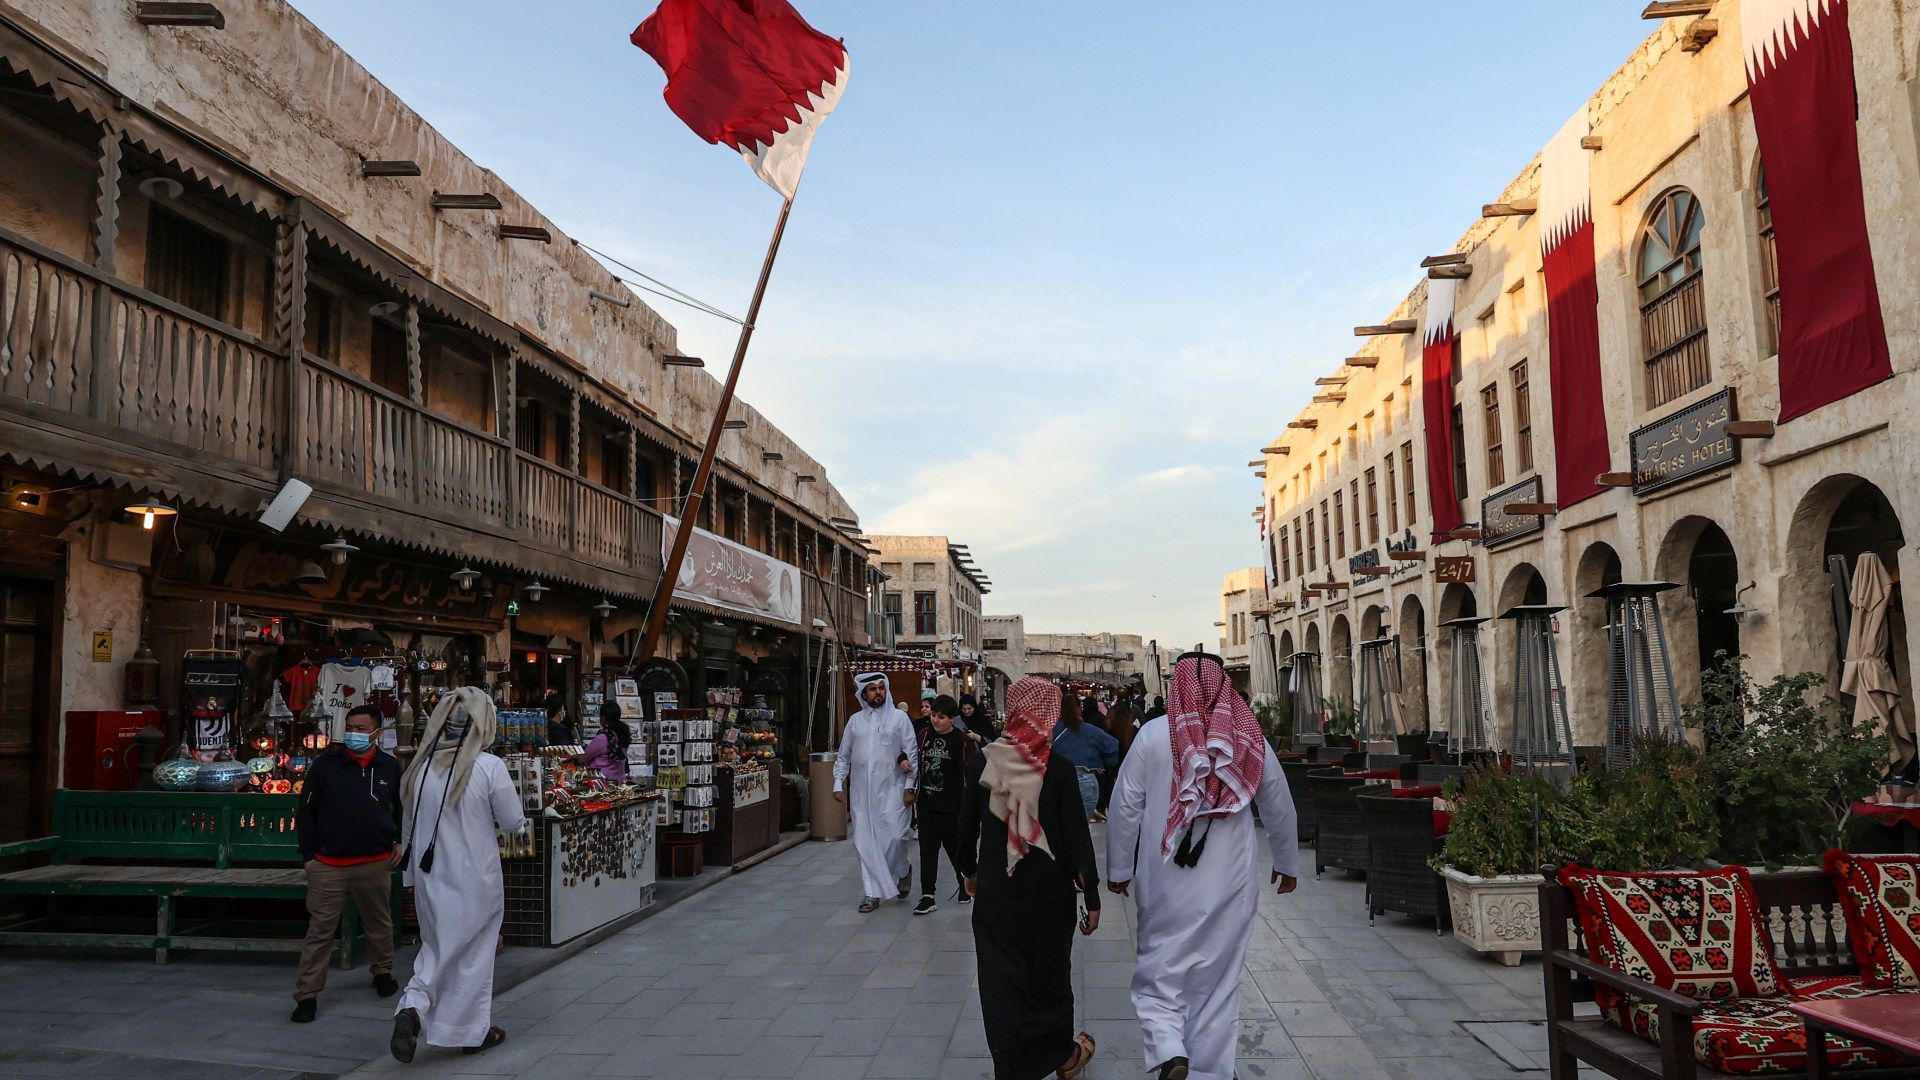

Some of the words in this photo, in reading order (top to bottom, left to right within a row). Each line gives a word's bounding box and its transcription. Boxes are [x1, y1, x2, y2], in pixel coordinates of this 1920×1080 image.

[1637, 453, 1685, 484] KHARISS
[1691, 438, 1732, 465] HOTEL
[1440, 561, 1472, 580] 24/7
[331, 683, 342, 694] I
[329, 697, 353, 710] Doha
